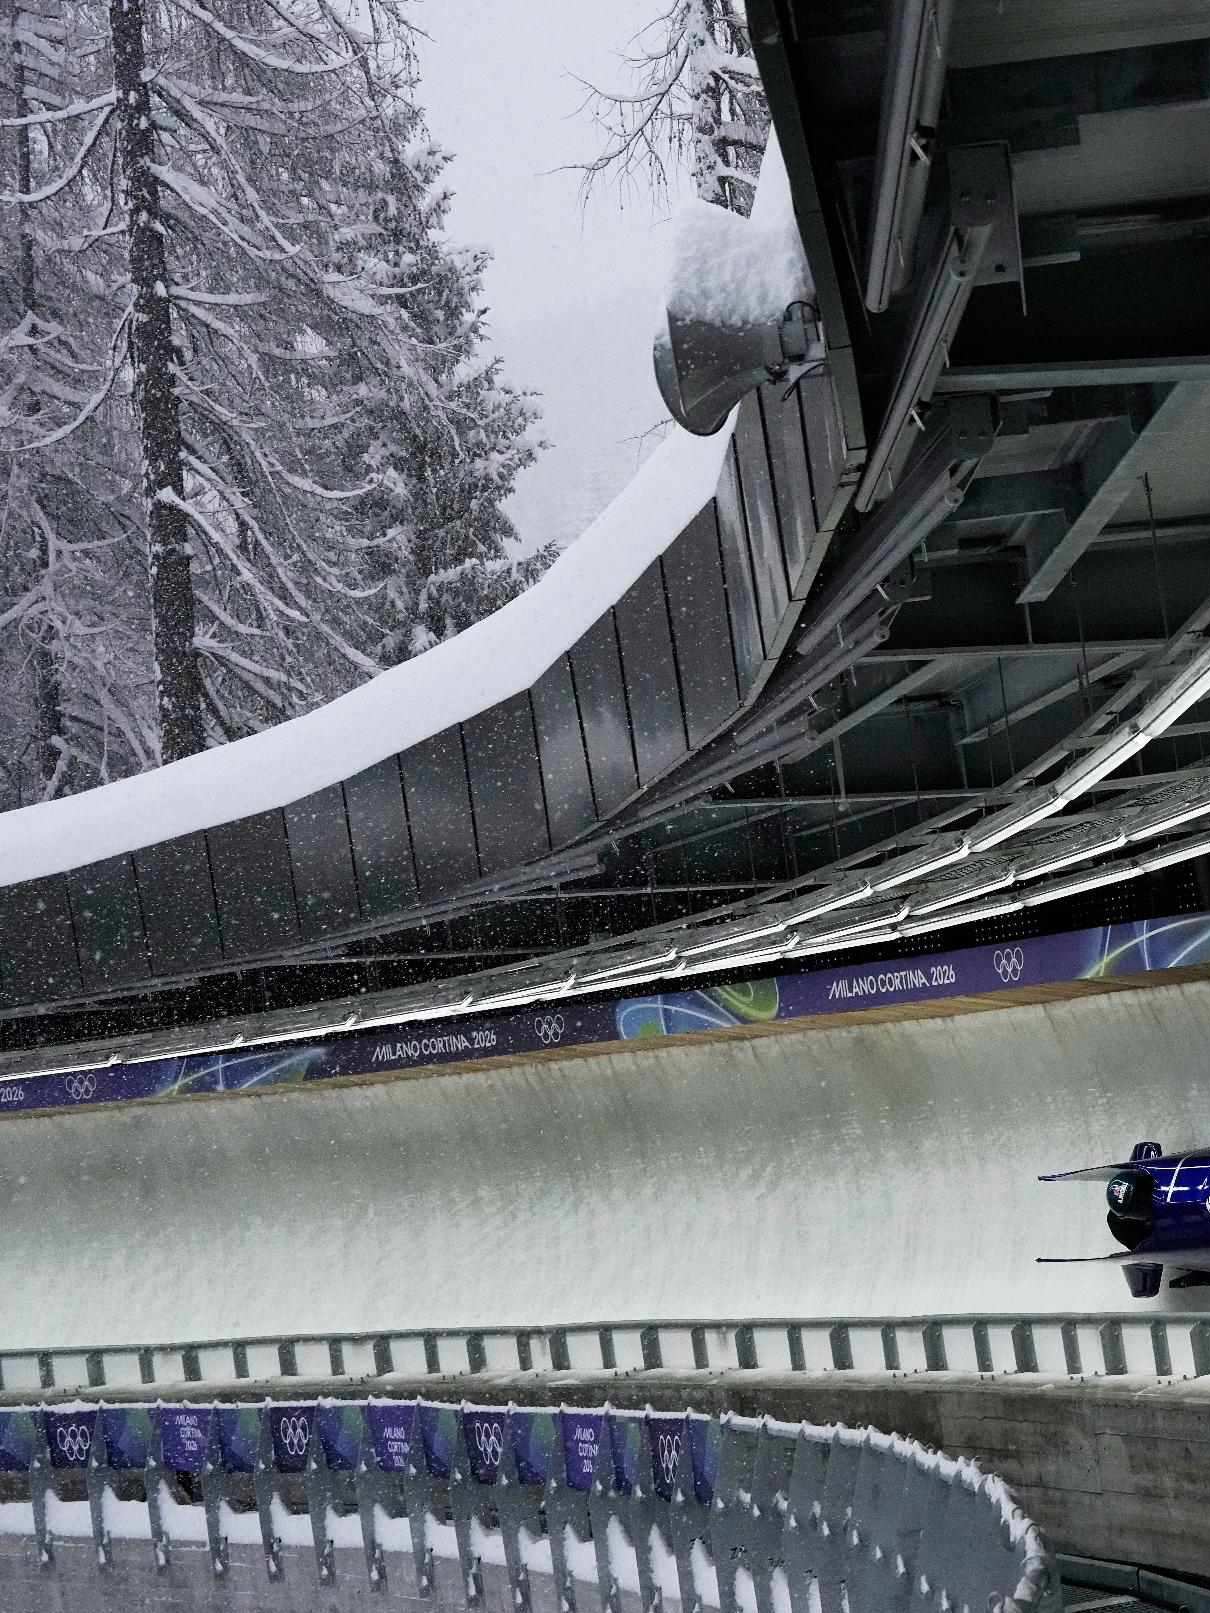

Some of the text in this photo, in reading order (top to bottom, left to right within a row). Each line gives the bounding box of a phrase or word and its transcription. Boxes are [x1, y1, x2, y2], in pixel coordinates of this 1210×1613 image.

[829, 964, 956, 1000] MILANO CORTINA 2026
[372, 1030, 497, 1062] MILANO CORTINA 2026
[0, 1086, 25, 1102] 2026
